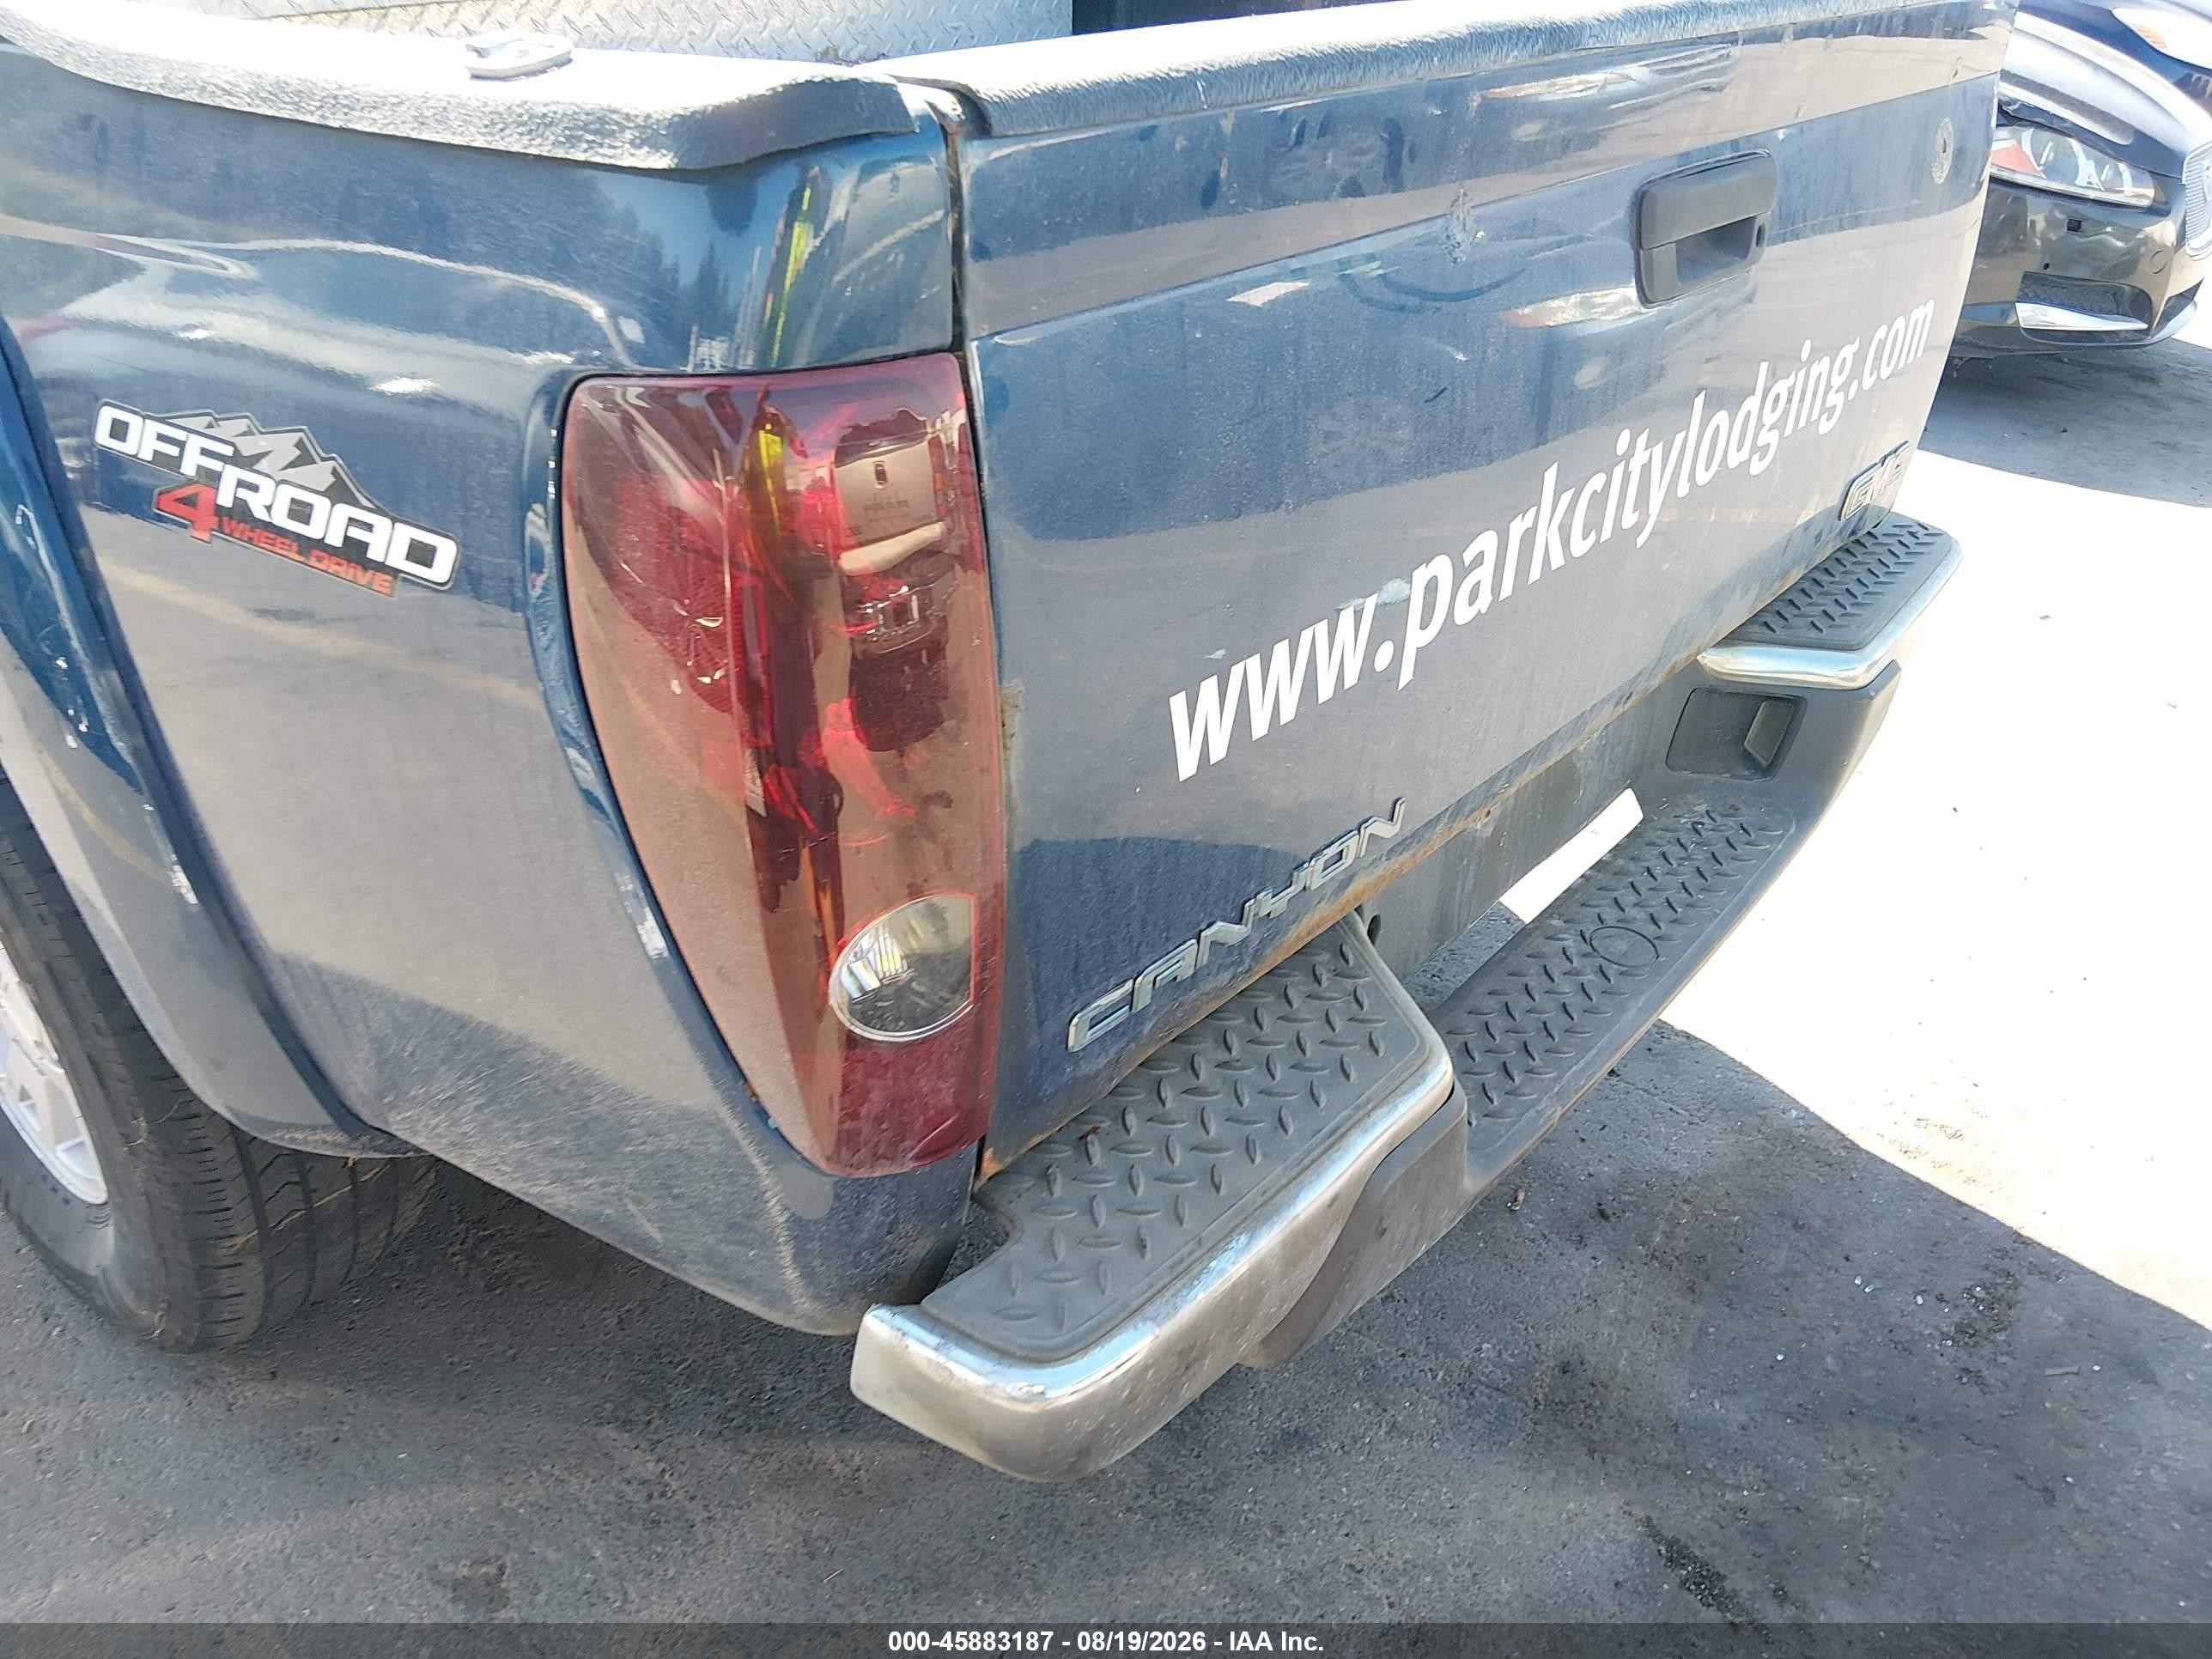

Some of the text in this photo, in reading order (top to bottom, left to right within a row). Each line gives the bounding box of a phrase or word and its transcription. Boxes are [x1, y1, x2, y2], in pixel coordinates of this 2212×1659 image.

[94, 405, 234, 477] OFF
[156, 483, 393, 594] 4 WHEEL DRIVE
[216, 465, 458, 583] ROAD
[1169, 300, 1935, 782] www.parkcitylodging.com
[1066, 797, 1405, 1053] CANYON
